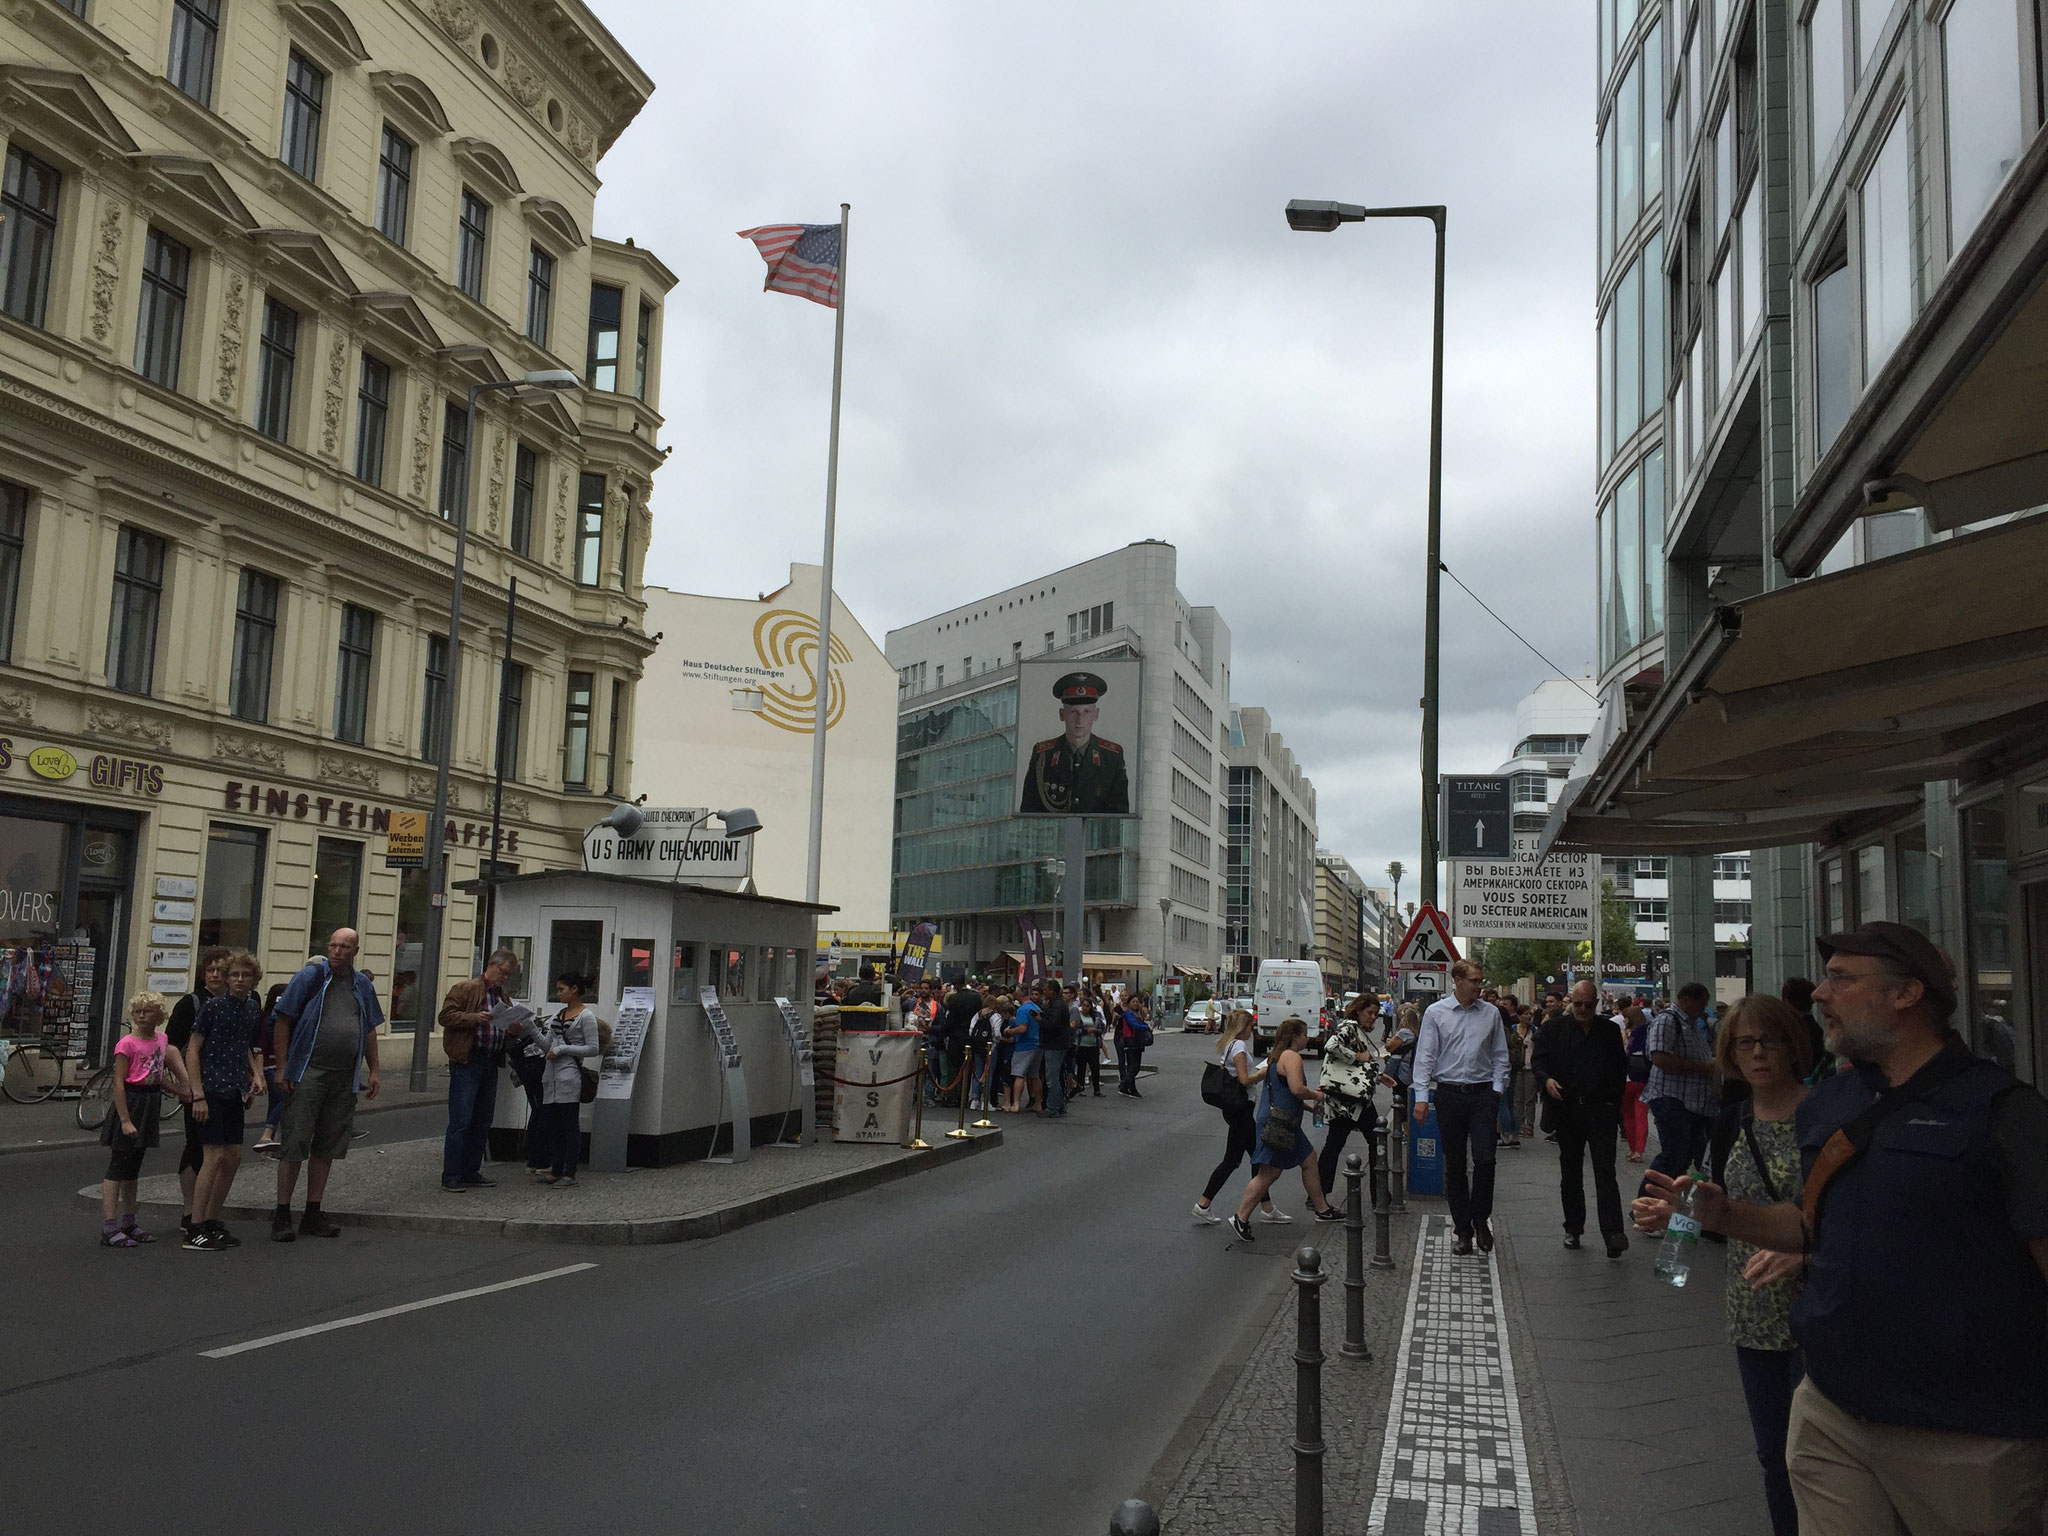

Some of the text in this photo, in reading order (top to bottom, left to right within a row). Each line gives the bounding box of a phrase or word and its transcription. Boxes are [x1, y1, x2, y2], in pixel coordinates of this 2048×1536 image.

[683, 660, 785, 678] Haus Deutscher Stiftungen
[682, 671, 757, 686] www.Stiftungen.org
[91, 754, 164, 794] GIFTS
[1456, 782, 1501, 790] TITANIC
[226, 781, 519, 852] EINSTEIN AFFEE
[661, 811, 696, 822] CHECKPOINT
[389, 833, 424, 843] Werben
[387, 846, 424, 854] Laternen!
[617, 840, 655, 860] ARMY
[659, 840, 741, 861] CHECKPOINT
[1547, 853, 1588, 864] SECTOR
[1465, 865, 1585, 878] ВЫ ВЫЕЗЖАЕТЕ ИЗ
[1463, 878, 1588, 891] АМЕРИКАНСКОГО СЕКТОРА
[1483, 892, 1567, 904] VOUS SORTEZ
[1463, 905, 1477, 915] DU
[1481, 905, 1527, 917] SECTEUR
[1463, 920, 1588, 931] SIE VERLASSEN DEN AMERIKANISCHEN SEKTOR
[907, 943, 926, 958] THE
[903, 955, 924, 969] WALL
[1561, 963, 1606, 974] Ceckpot
[1607, 962, 1636, 973] Charlie
[855, 1131, 887, 1139] STAMP
